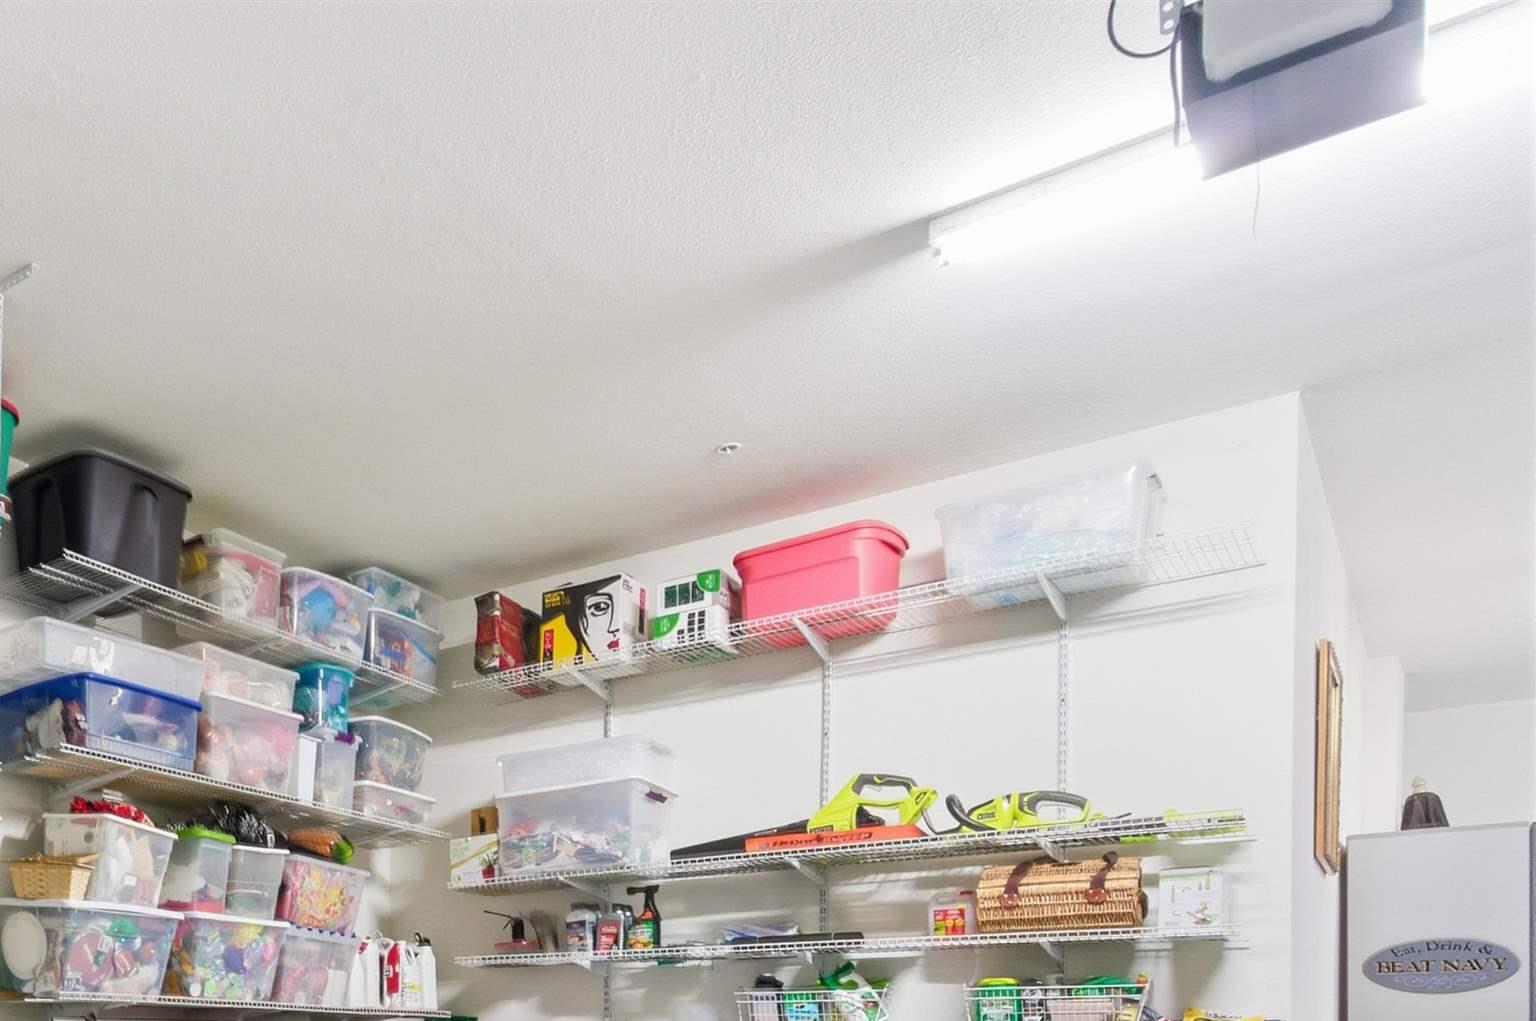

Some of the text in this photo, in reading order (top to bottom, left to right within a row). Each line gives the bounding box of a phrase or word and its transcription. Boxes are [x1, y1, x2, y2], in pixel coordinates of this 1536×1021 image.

[1390, 946, 1422, 958] Eat,
[1426, 940, 1473, 952] Drink
[1375, 957, 1508, 974] BEAT NAVY
